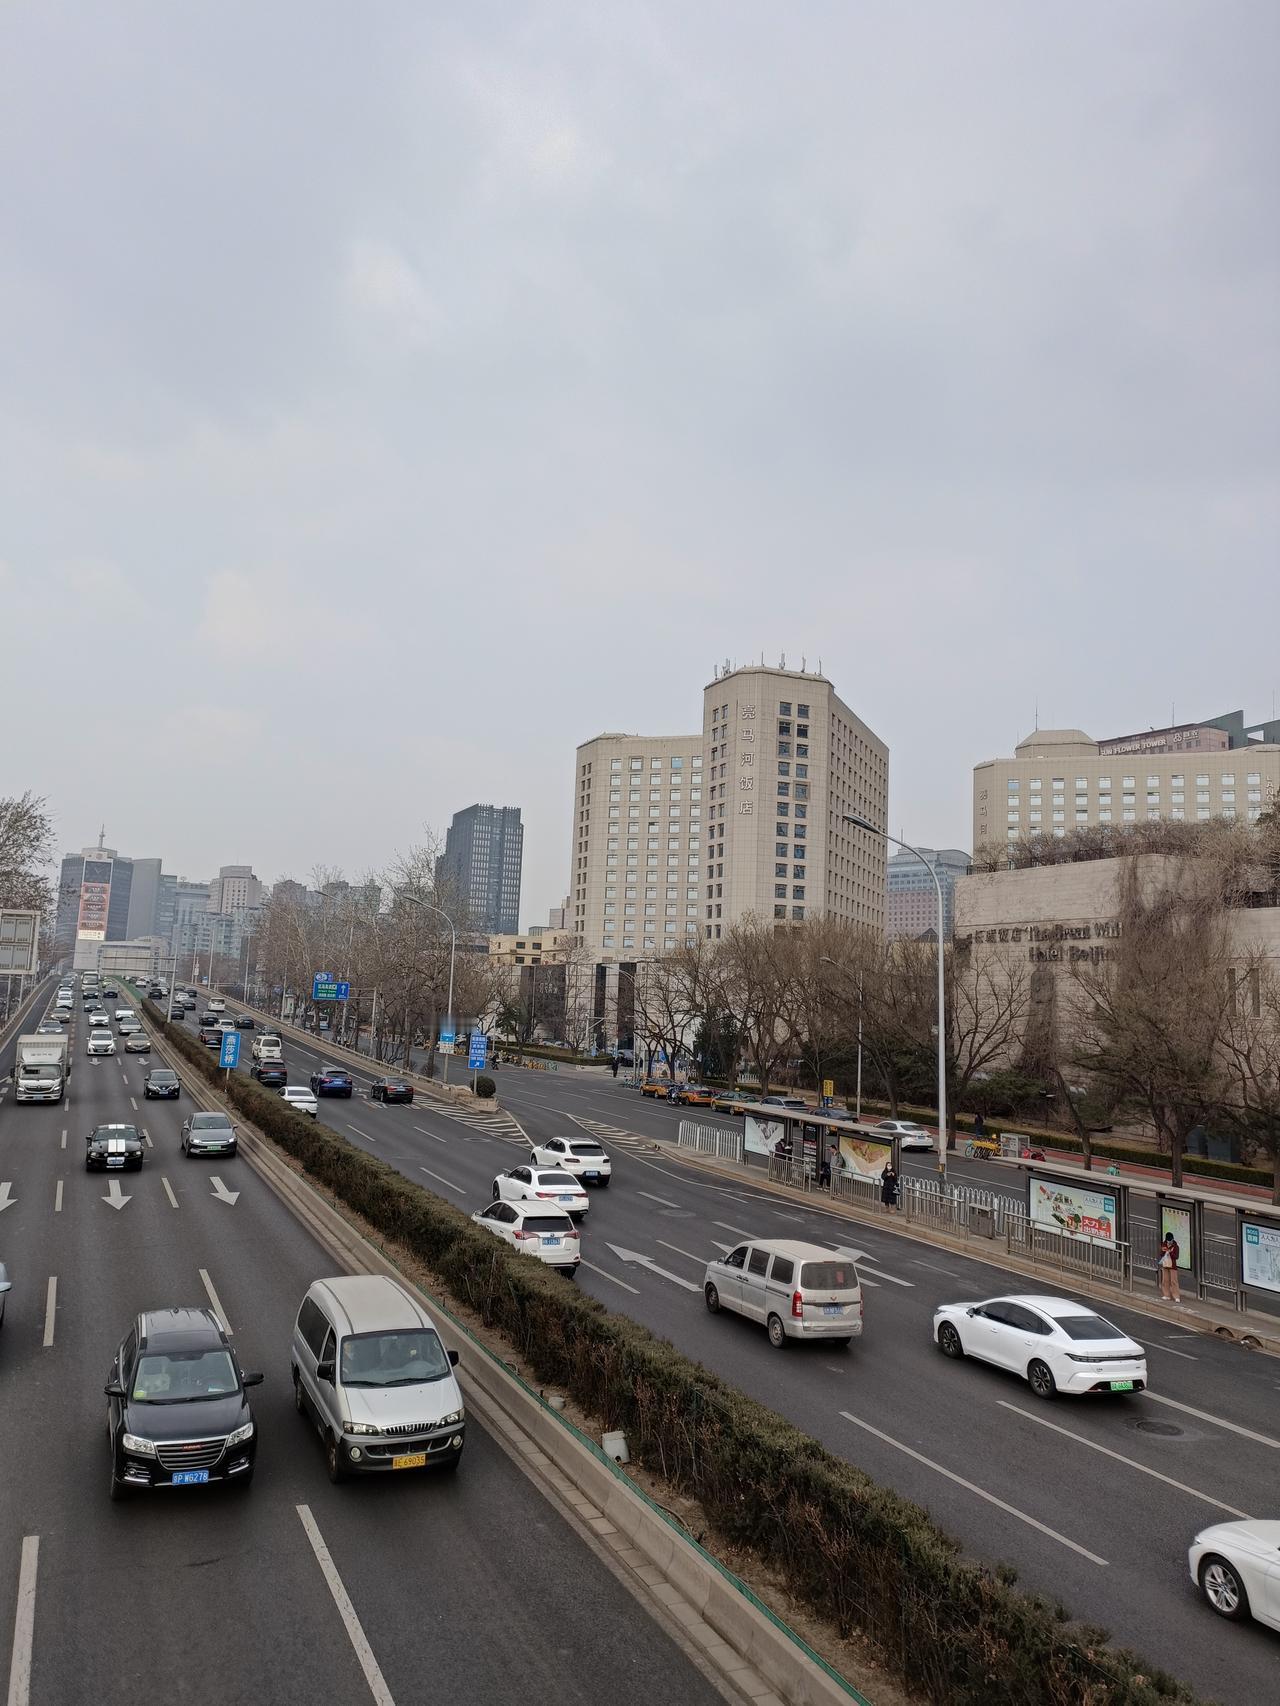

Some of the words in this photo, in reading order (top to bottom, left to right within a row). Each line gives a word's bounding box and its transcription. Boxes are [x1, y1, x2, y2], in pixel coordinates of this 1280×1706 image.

[740, 704, 756, 816] 亮马河饭店
[1114, 743, 1142, 755] FLOWER
[1143, 738, 1167, 750] TOWER
[223, 1035, 237, 1064] 燕莎桥
